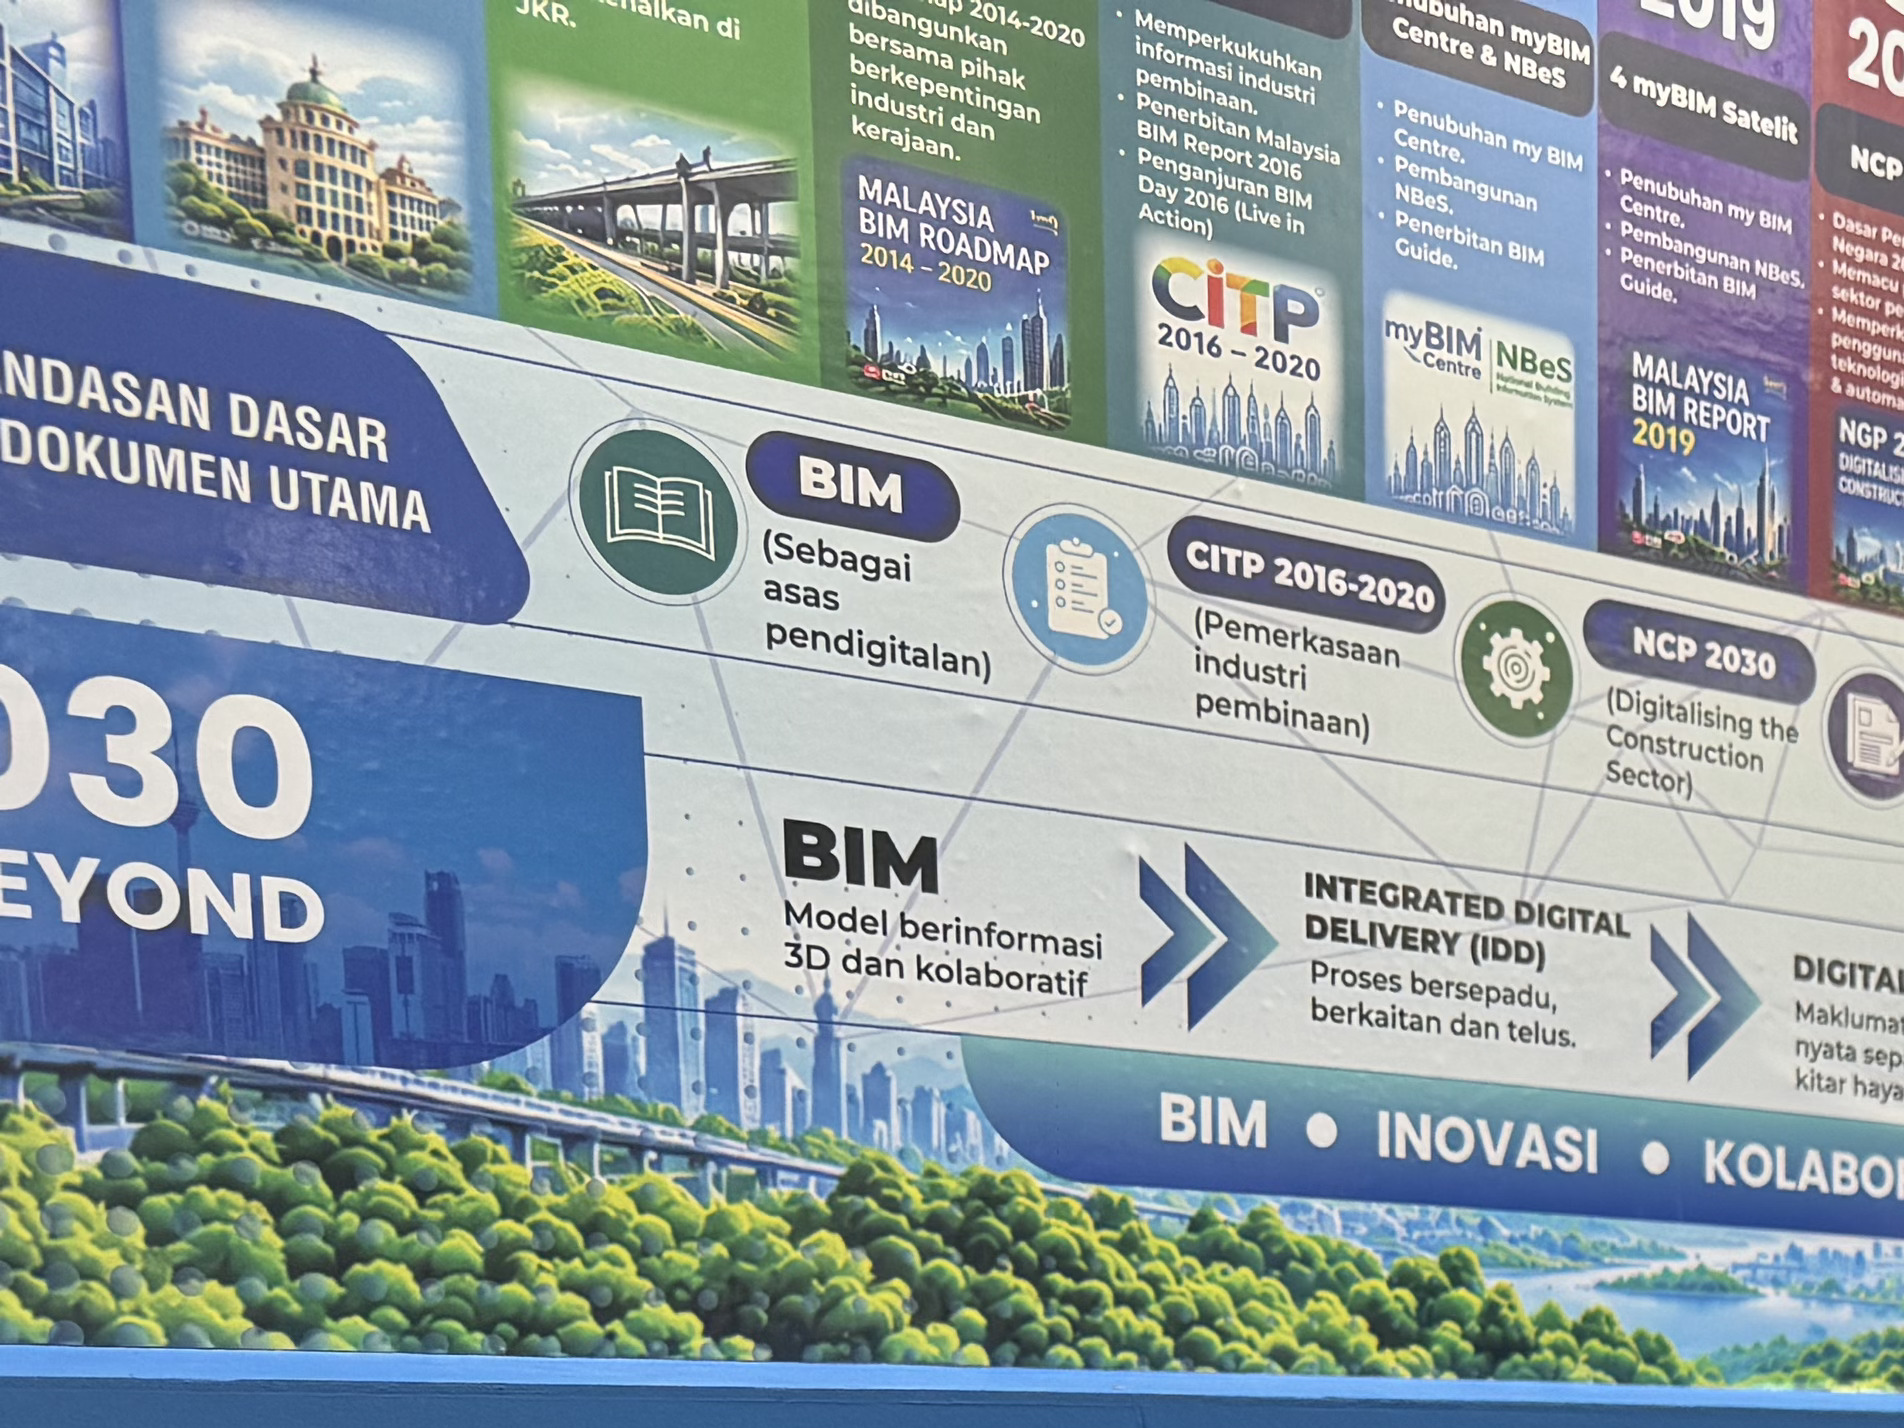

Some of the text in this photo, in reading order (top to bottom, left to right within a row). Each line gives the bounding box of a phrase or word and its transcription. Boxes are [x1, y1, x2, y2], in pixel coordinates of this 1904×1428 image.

[849, 22, 1026, 90] bersama pihak
[1135, 9, 1322, 81] Memperkukuhkan
[1135, 35, 1316, 105] informasi industri
[850, 53, 1041, 124] berkepentingan
[1136, 92, 1340, 167] Penerbitan Malaysia
[1850, 144, 1903, 182] NCP
[857, 175, 994, 233] MALAYSIA
[858, 208, 1050, 276] BIM ROADMAP
[860, 243, 992, 293] 2014 2020
[1157, 322, 1321, 383] 2016 2020
[1633, 351, 1750, 407] MALAYSIA
[0, 350, 388, 463] NDASAN DASAR
[1633, 385, 1771, 444] BIM REPORT
[1632, 418, 1696, 457] 2019
[0, 417, 432, 534] DOKUMEN UTAMA
[799, 455, 904, 514] BIM
[763, 528, 912, 583] (Sebagai
[1186, 540, 1436, 615] CITP 2016-2020
[763, 577, 840, 612] asas
[765, 619, 992, 685] pendigitalan)
[1194, 606, 1401, 669] (Pemerkasaan
[1633, 628, 1777, 682] NCP 2030
[1195, 647, 1307, 692] industri
[1196, 689, 1370, 745] pembinaan)
[783, 818, 939, 894] BIM
[784, 900, 1103, 961] Model berinformasi
[1304, 872, 1631, 939] INTEGRATED DIGITAL
[783, 942, 1088, 998] 3D dan kolaboratif
[1305, 914, 1547, 973] DELIVERY (IDD)
[1311, 959, 1558, 1014] Proses bersepadu,
[1311, 997, 1577, 1049] berkaitan dan telus.
[1160, 1092, 1267, 1149] BIM
[1378, 1109, 1598, 1175] INOVASI
